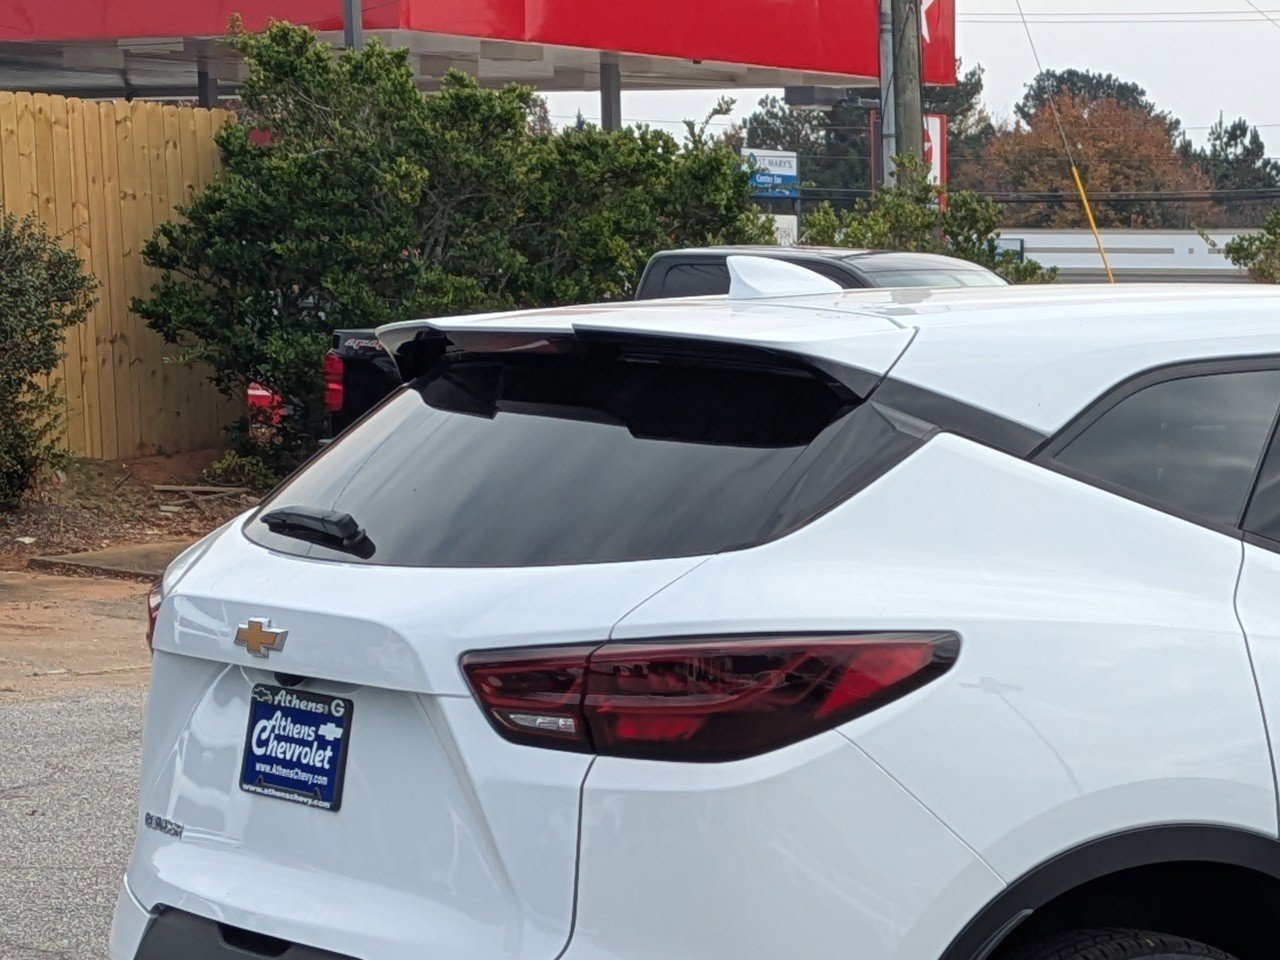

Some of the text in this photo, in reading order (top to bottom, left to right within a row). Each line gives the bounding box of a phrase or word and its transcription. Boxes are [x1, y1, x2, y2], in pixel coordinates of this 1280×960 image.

[274, 690, 324, 713] Athens
[268, 710, 316, 741] Athens
[252, 719, 334, 769] Chevrolet
[255, 762, 328, 785] www.AthensChevy.com
